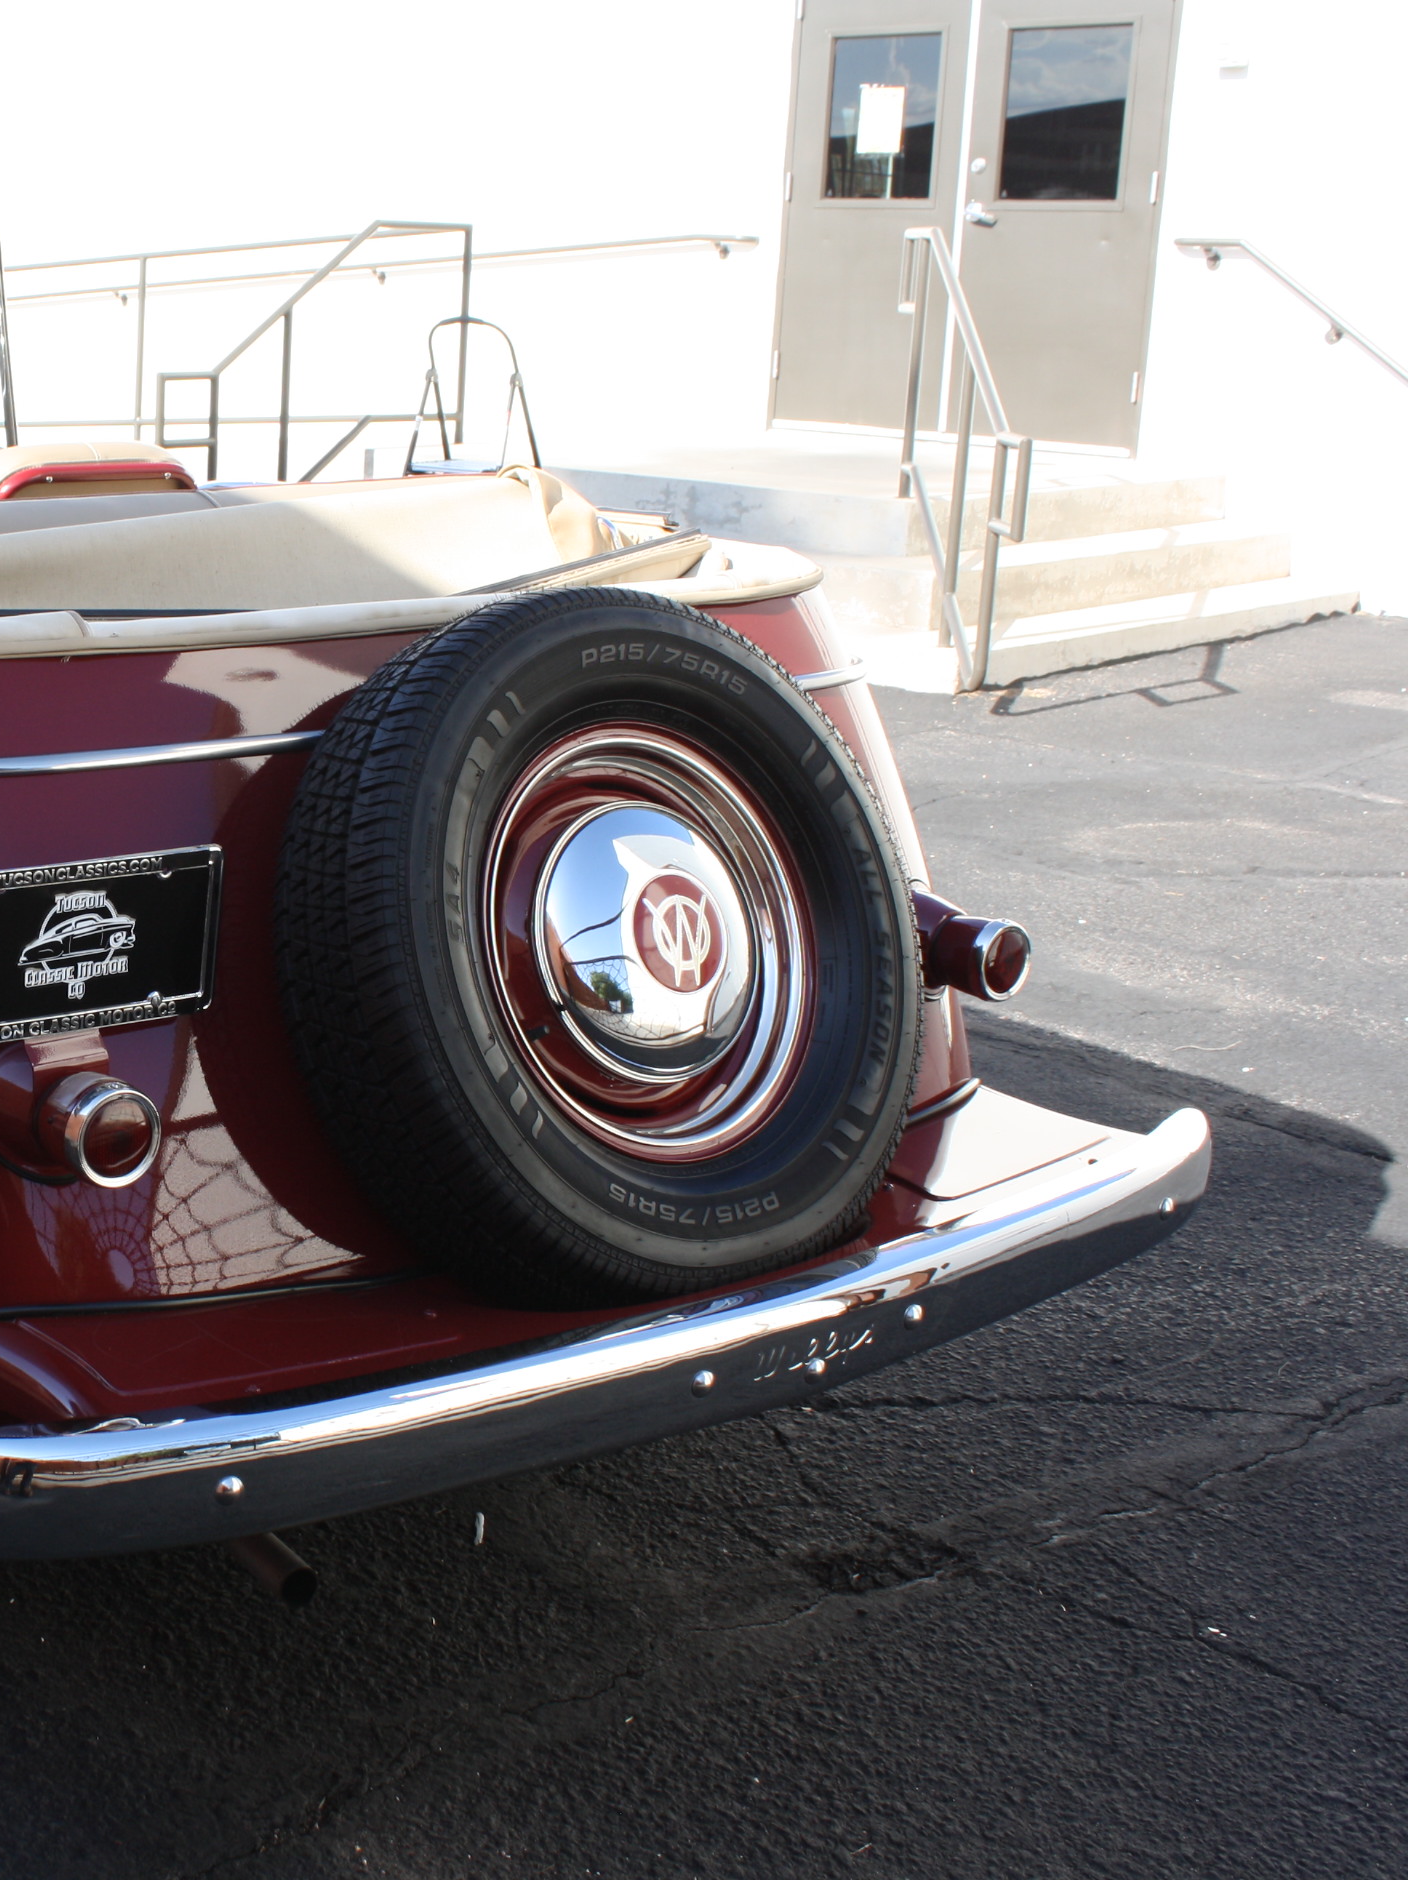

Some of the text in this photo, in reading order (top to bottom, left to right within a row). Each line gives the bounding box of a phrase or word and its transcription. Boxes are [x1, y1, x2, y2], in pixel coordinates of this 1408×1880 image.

[581, 643, 748, 695] P215/75R15
[852, 847, 883, 906] ALL
[29, 1013, 95, 1036] CLASSIC
[99, 1004, 154, 1026] MOTOR
[868, 929, 894, 1068] SEASON
[608, 1183, 780, 1226] P215/75R15
